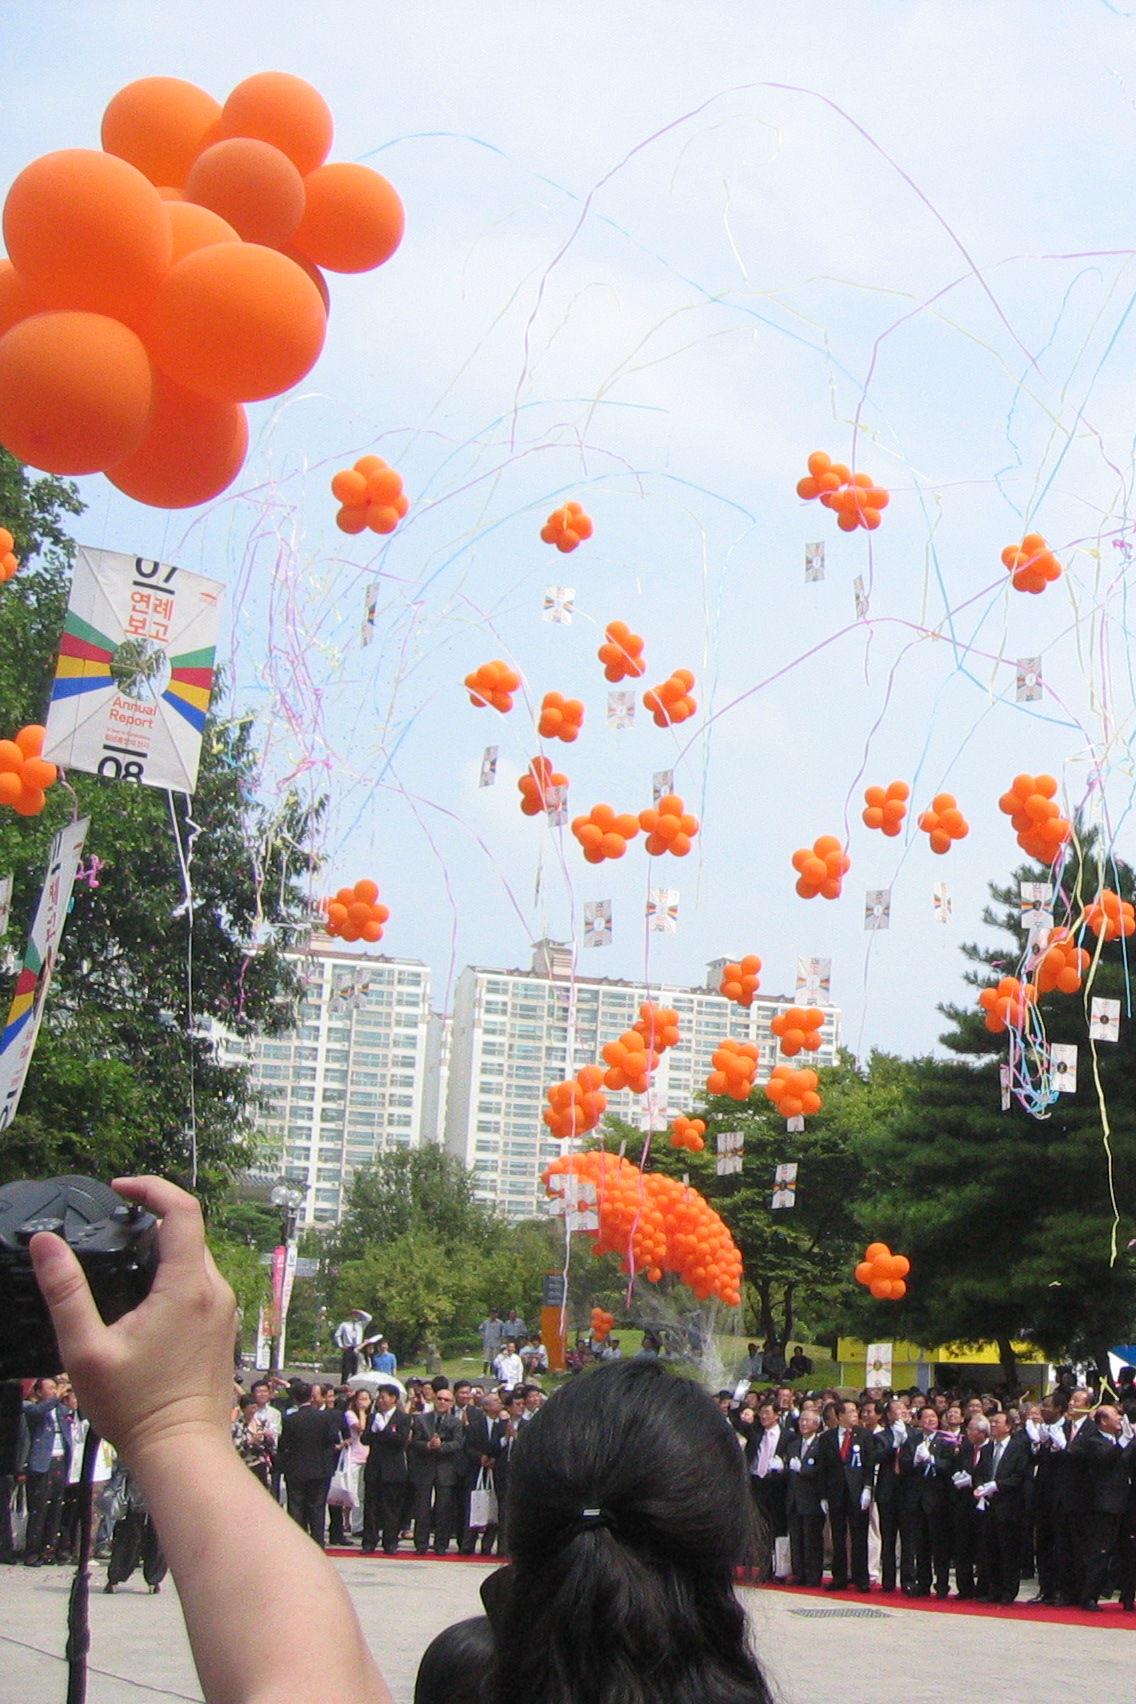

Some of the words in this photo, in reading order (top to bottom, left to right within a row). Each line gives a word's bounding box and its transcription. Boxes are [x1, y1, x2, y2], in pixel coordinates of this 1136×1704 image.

[131, 591, 174, 621] 연례
[124, 615, 169, 643] 보고
[113, 696, 157, 716] Annual
[109, 708, 154, 729] Report
